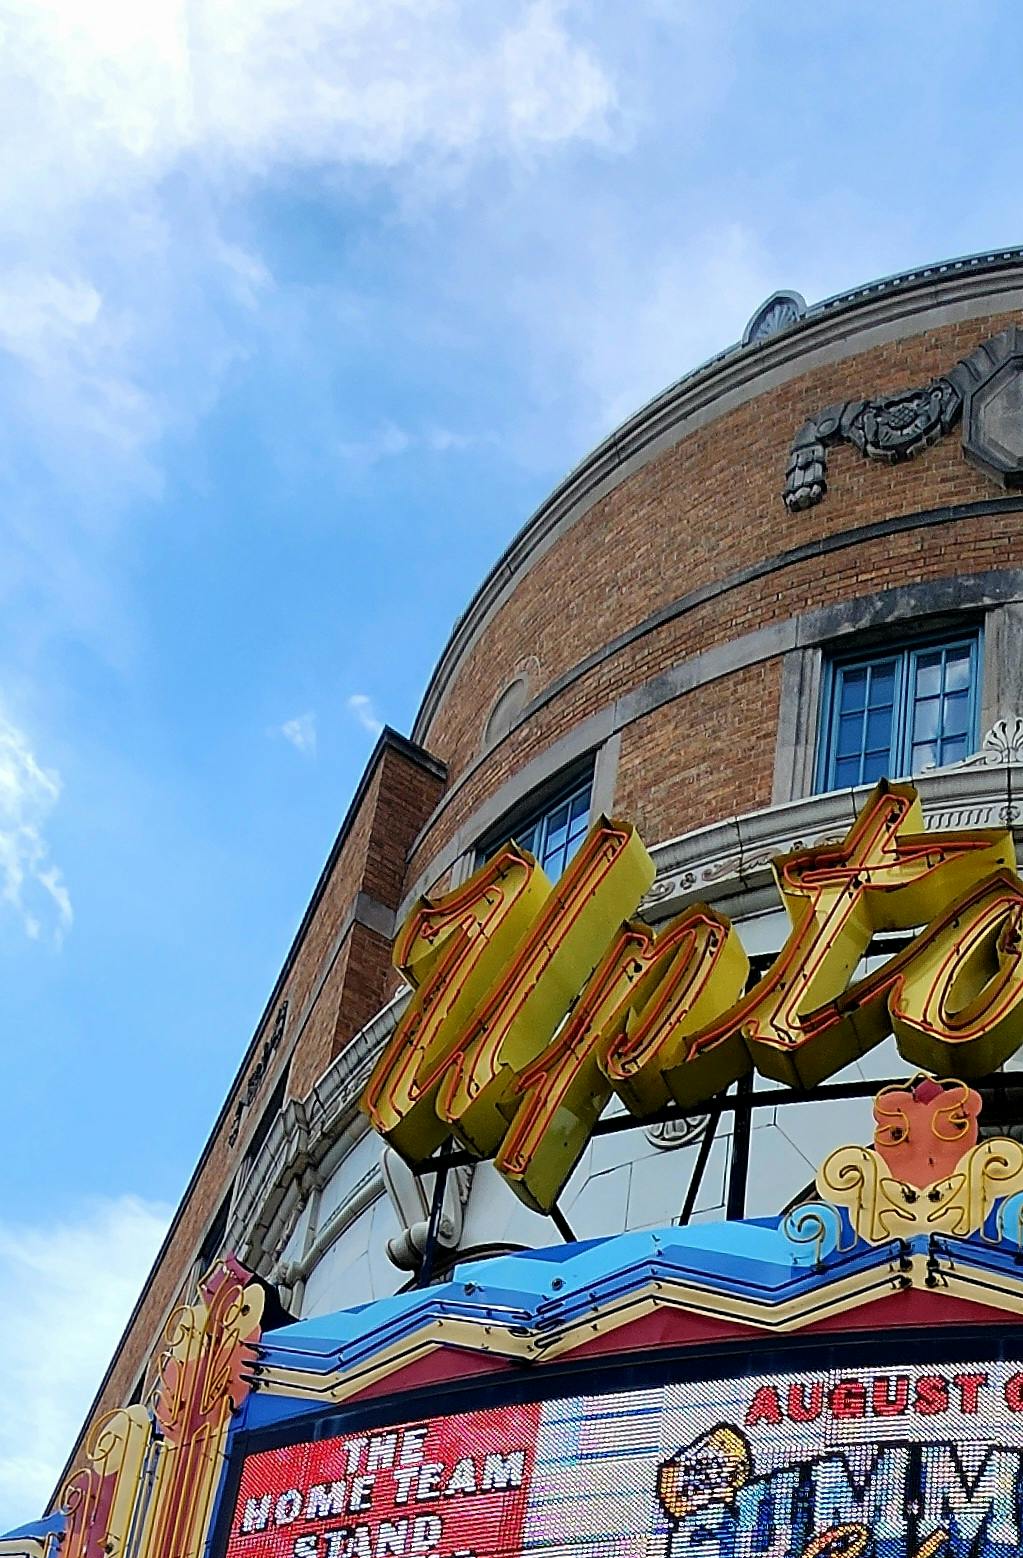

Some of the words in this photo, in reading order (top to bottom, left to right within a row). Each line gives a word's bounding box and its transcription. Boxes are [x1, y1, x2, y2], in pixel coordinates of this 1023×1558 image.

[745, 1372, 988, 1427] AUGUST
[343, 1427, 430, 1476] THE
[240, 1475, 374, 1536] HOME
[392, 1450, 527, 1506] TEAM
